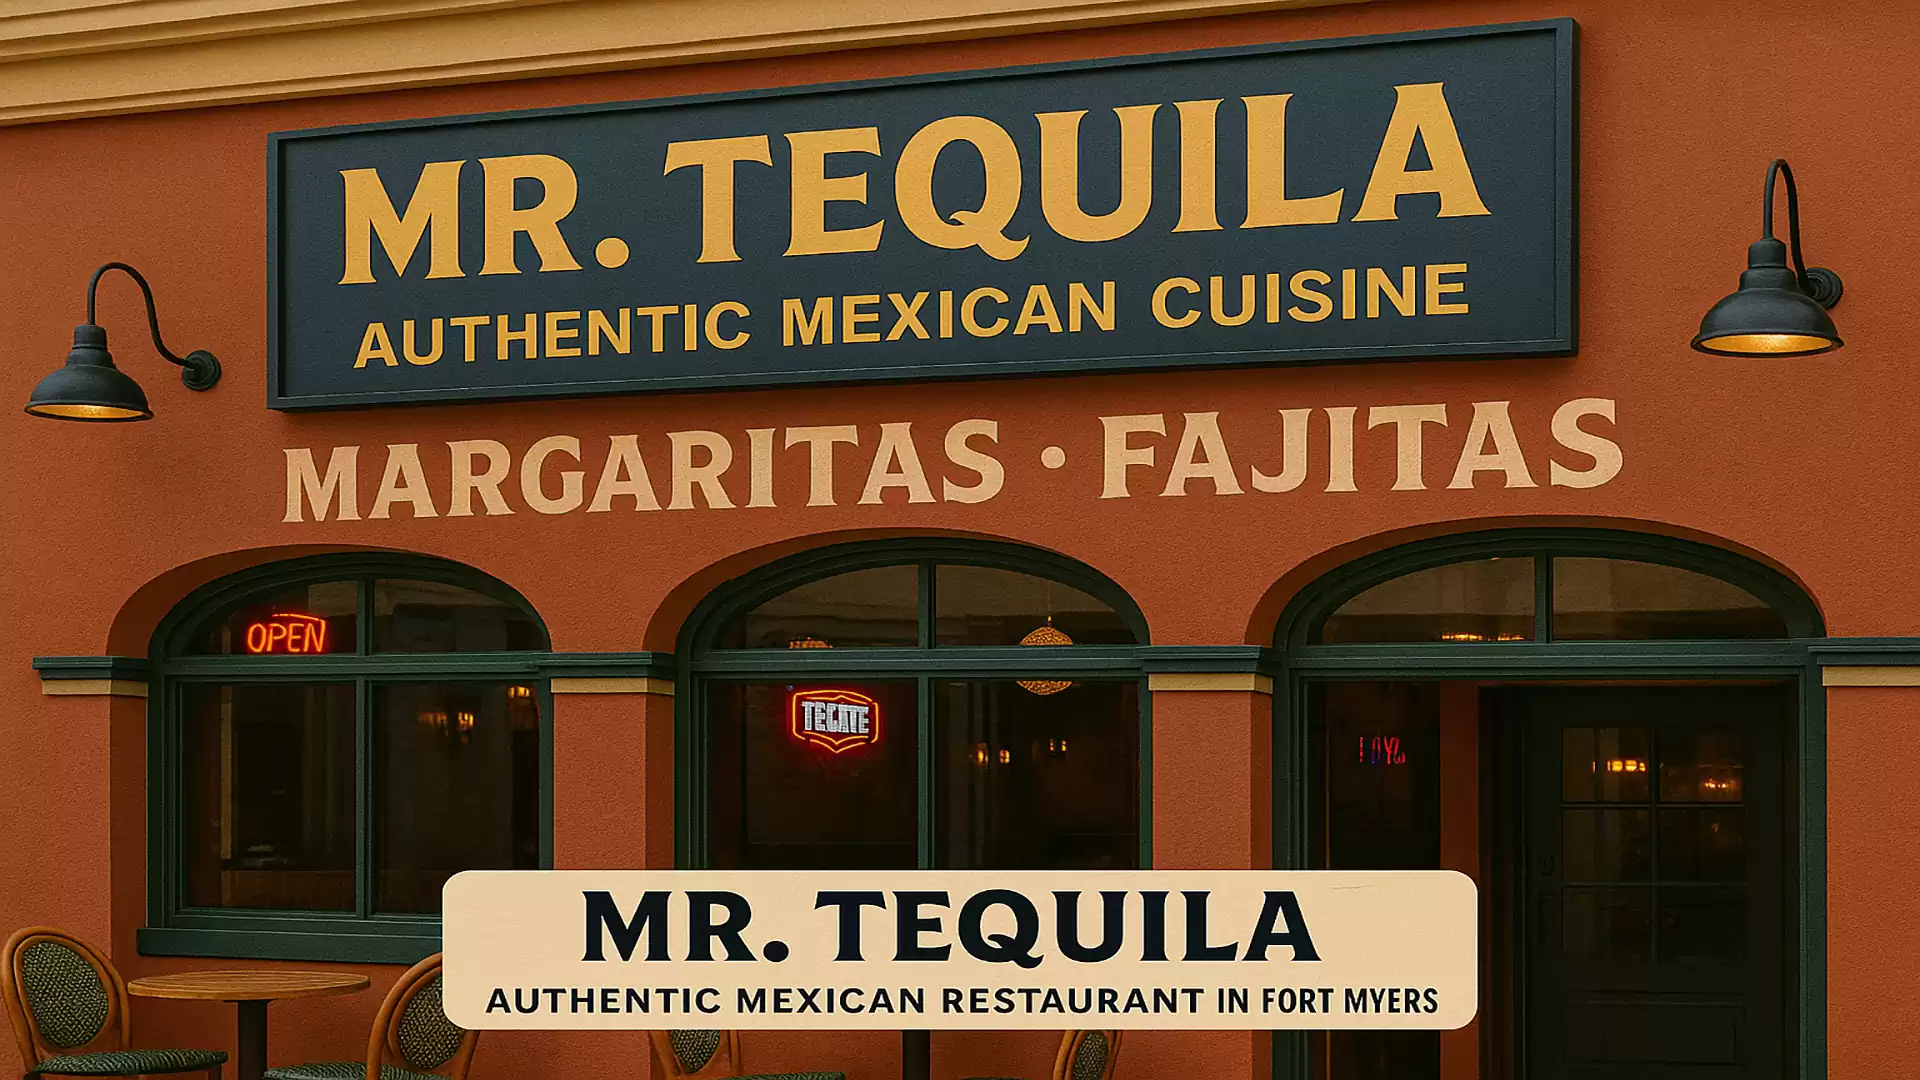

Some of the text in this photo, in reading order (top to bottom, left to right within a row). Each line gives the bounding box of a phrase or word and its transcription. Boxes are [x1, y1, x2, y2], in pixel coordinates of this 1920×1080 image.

[339, 82, 1489, 284] MR. TEQUILA
[354, 263, 1468, 368] AUTHENTIC MEXICAN CUISINE
[282, 398, 1622, 522] MARGARITAS FAJITAS
[247, 619, 325, 653] OPEN
[800, 701, 869, 734] TECATE
